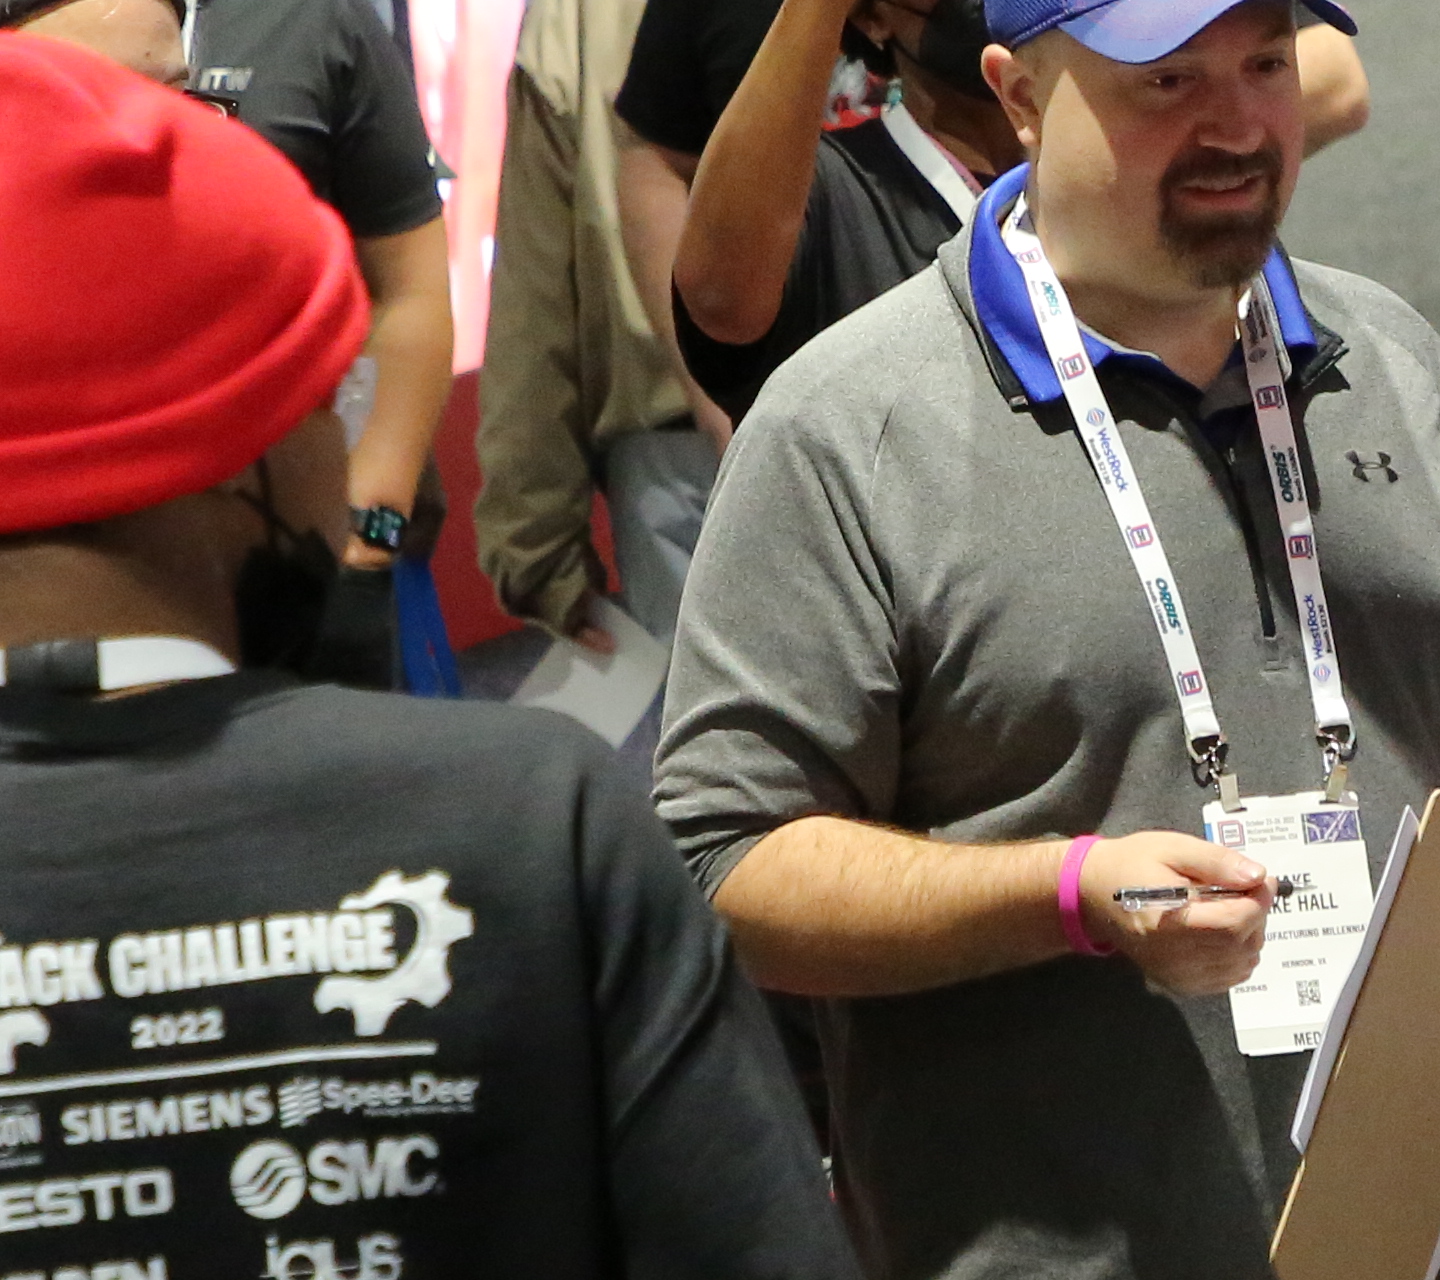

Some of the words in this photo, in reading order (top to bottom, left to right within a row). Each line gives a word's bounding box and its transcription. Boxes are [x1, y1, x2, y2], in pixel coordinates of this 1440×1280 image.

[1097, 427, 1128, 493] WestRock
[1273, 451, 1294, 503] ORBIS
[1155, 577, 1180, 630] ORBIS
[1303, 593, 1323, 660] WestRock
[1267, 895, 1292, 915] KE
[1297, 892, 1339, 912] HALL
[1276, 872, 1312, 886] AKE
[108, 908, 398, 1000] CHALLENGE
[1264, 928, 1320, 942] UFACTURING
[1322, 924, 1367, 937] MILLENNIA
[130, 1007, 225, 1050] 2022
[1293, 1030, 1322, 1047] MED
[60, 1083, 275, 1146] SIEMENS
[308, 1133, 440, 1206] SMC
